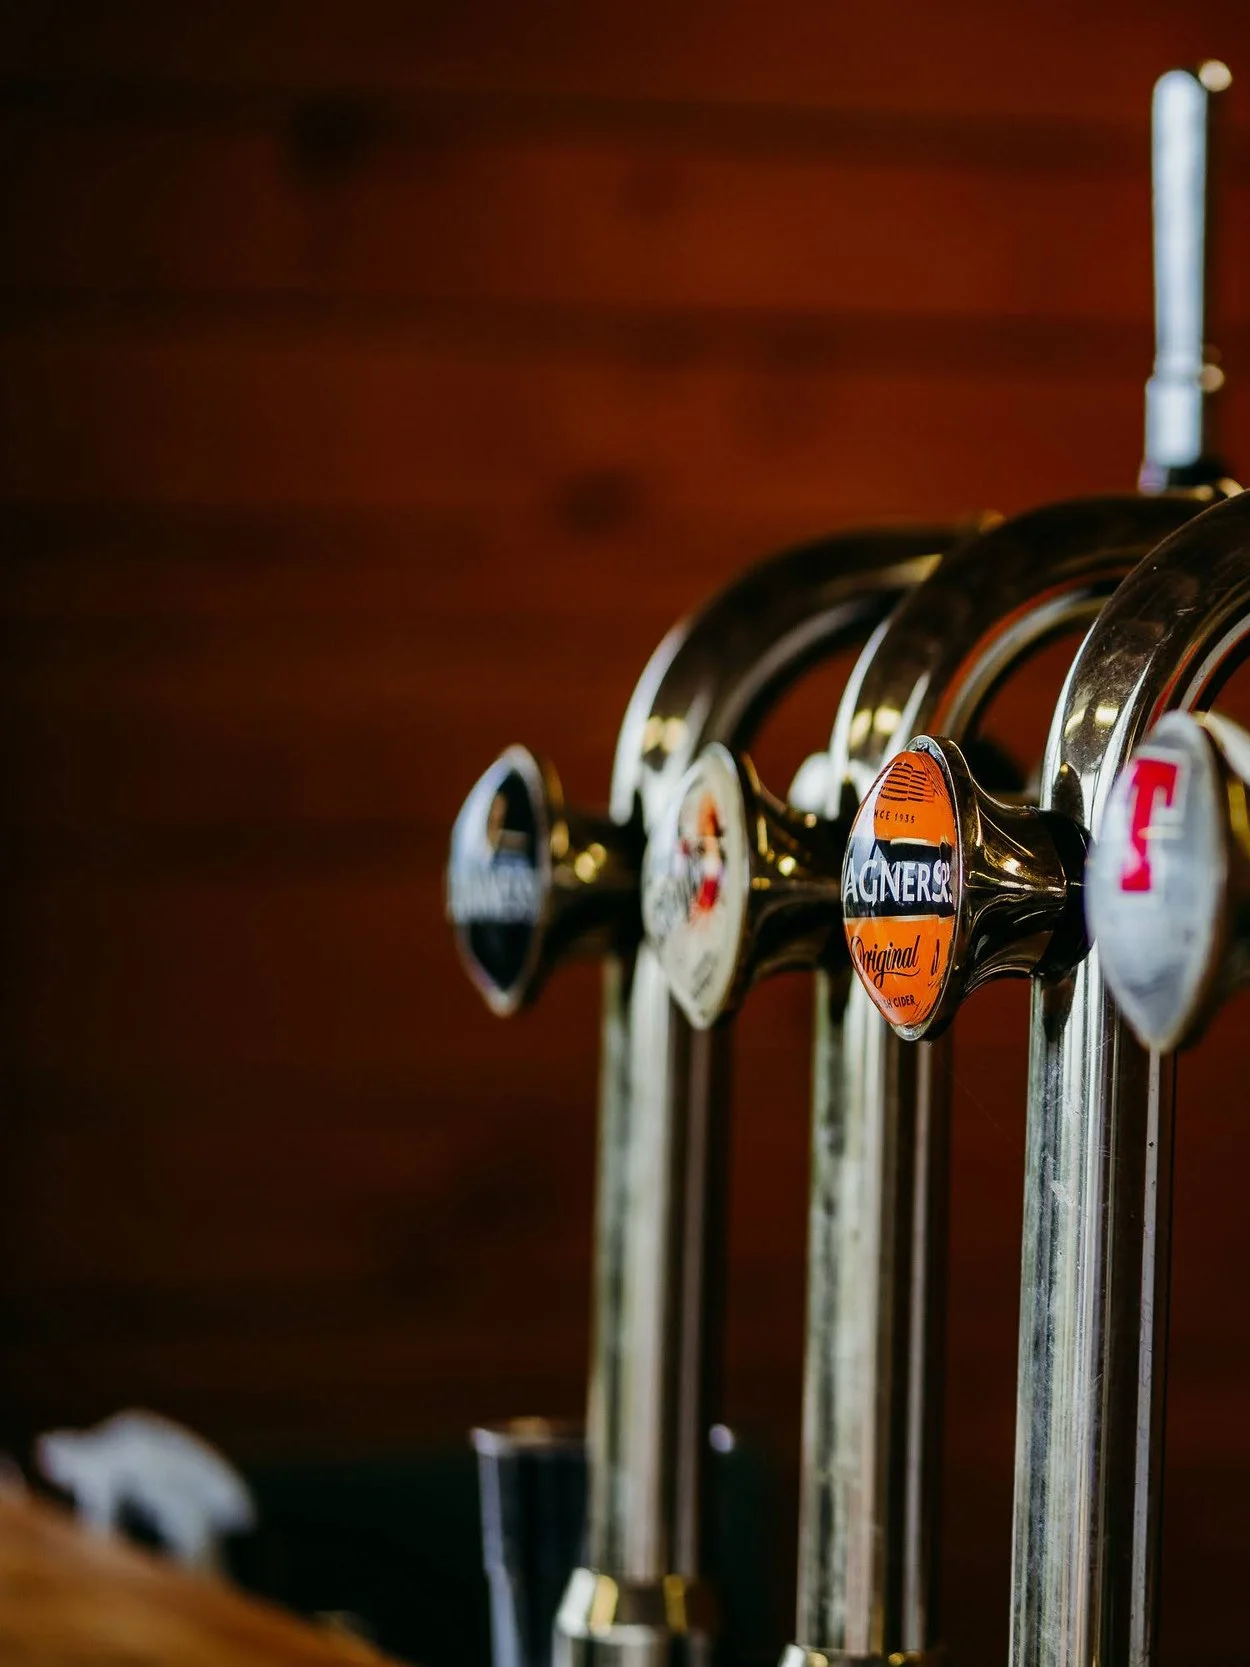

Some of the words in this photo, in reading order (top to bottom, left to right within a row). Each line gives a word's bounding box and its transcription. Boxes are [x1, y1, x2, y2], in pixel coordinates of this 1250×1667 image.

[1118, 752, 1183, 897] T
[842, 858, 949, 903] AGNERS
[851, 935, 921, 989] Original
[893, 994, 916, 1009] CIDER
